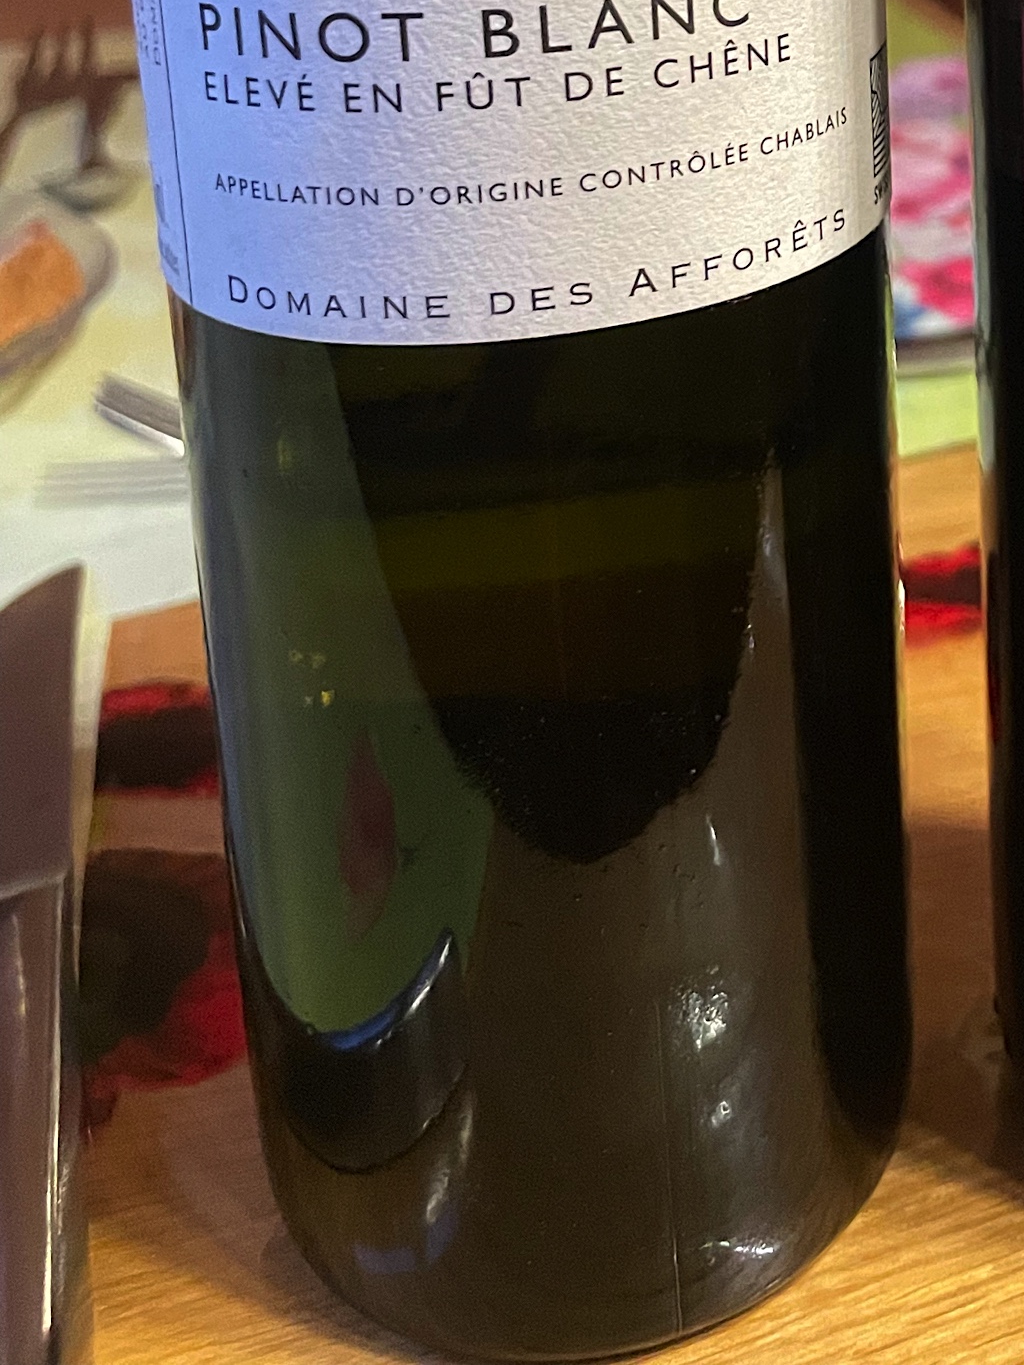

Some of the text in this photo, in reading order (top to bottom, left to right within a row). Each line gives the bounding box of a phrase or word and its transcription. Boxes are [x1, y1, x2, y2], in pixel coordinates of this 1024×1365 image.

[198, 1, 425, 64] PINOT
[203, 32, 794, 115] ELEVÉ EN FÛT DE CHÊNE
[213, 106, 849, 208] APPELLATION D'ORIGINE CONTRÔLÉE CHABLAIS
[226, 208, 848, 321] DOMAINE DES AFFORÊTS
